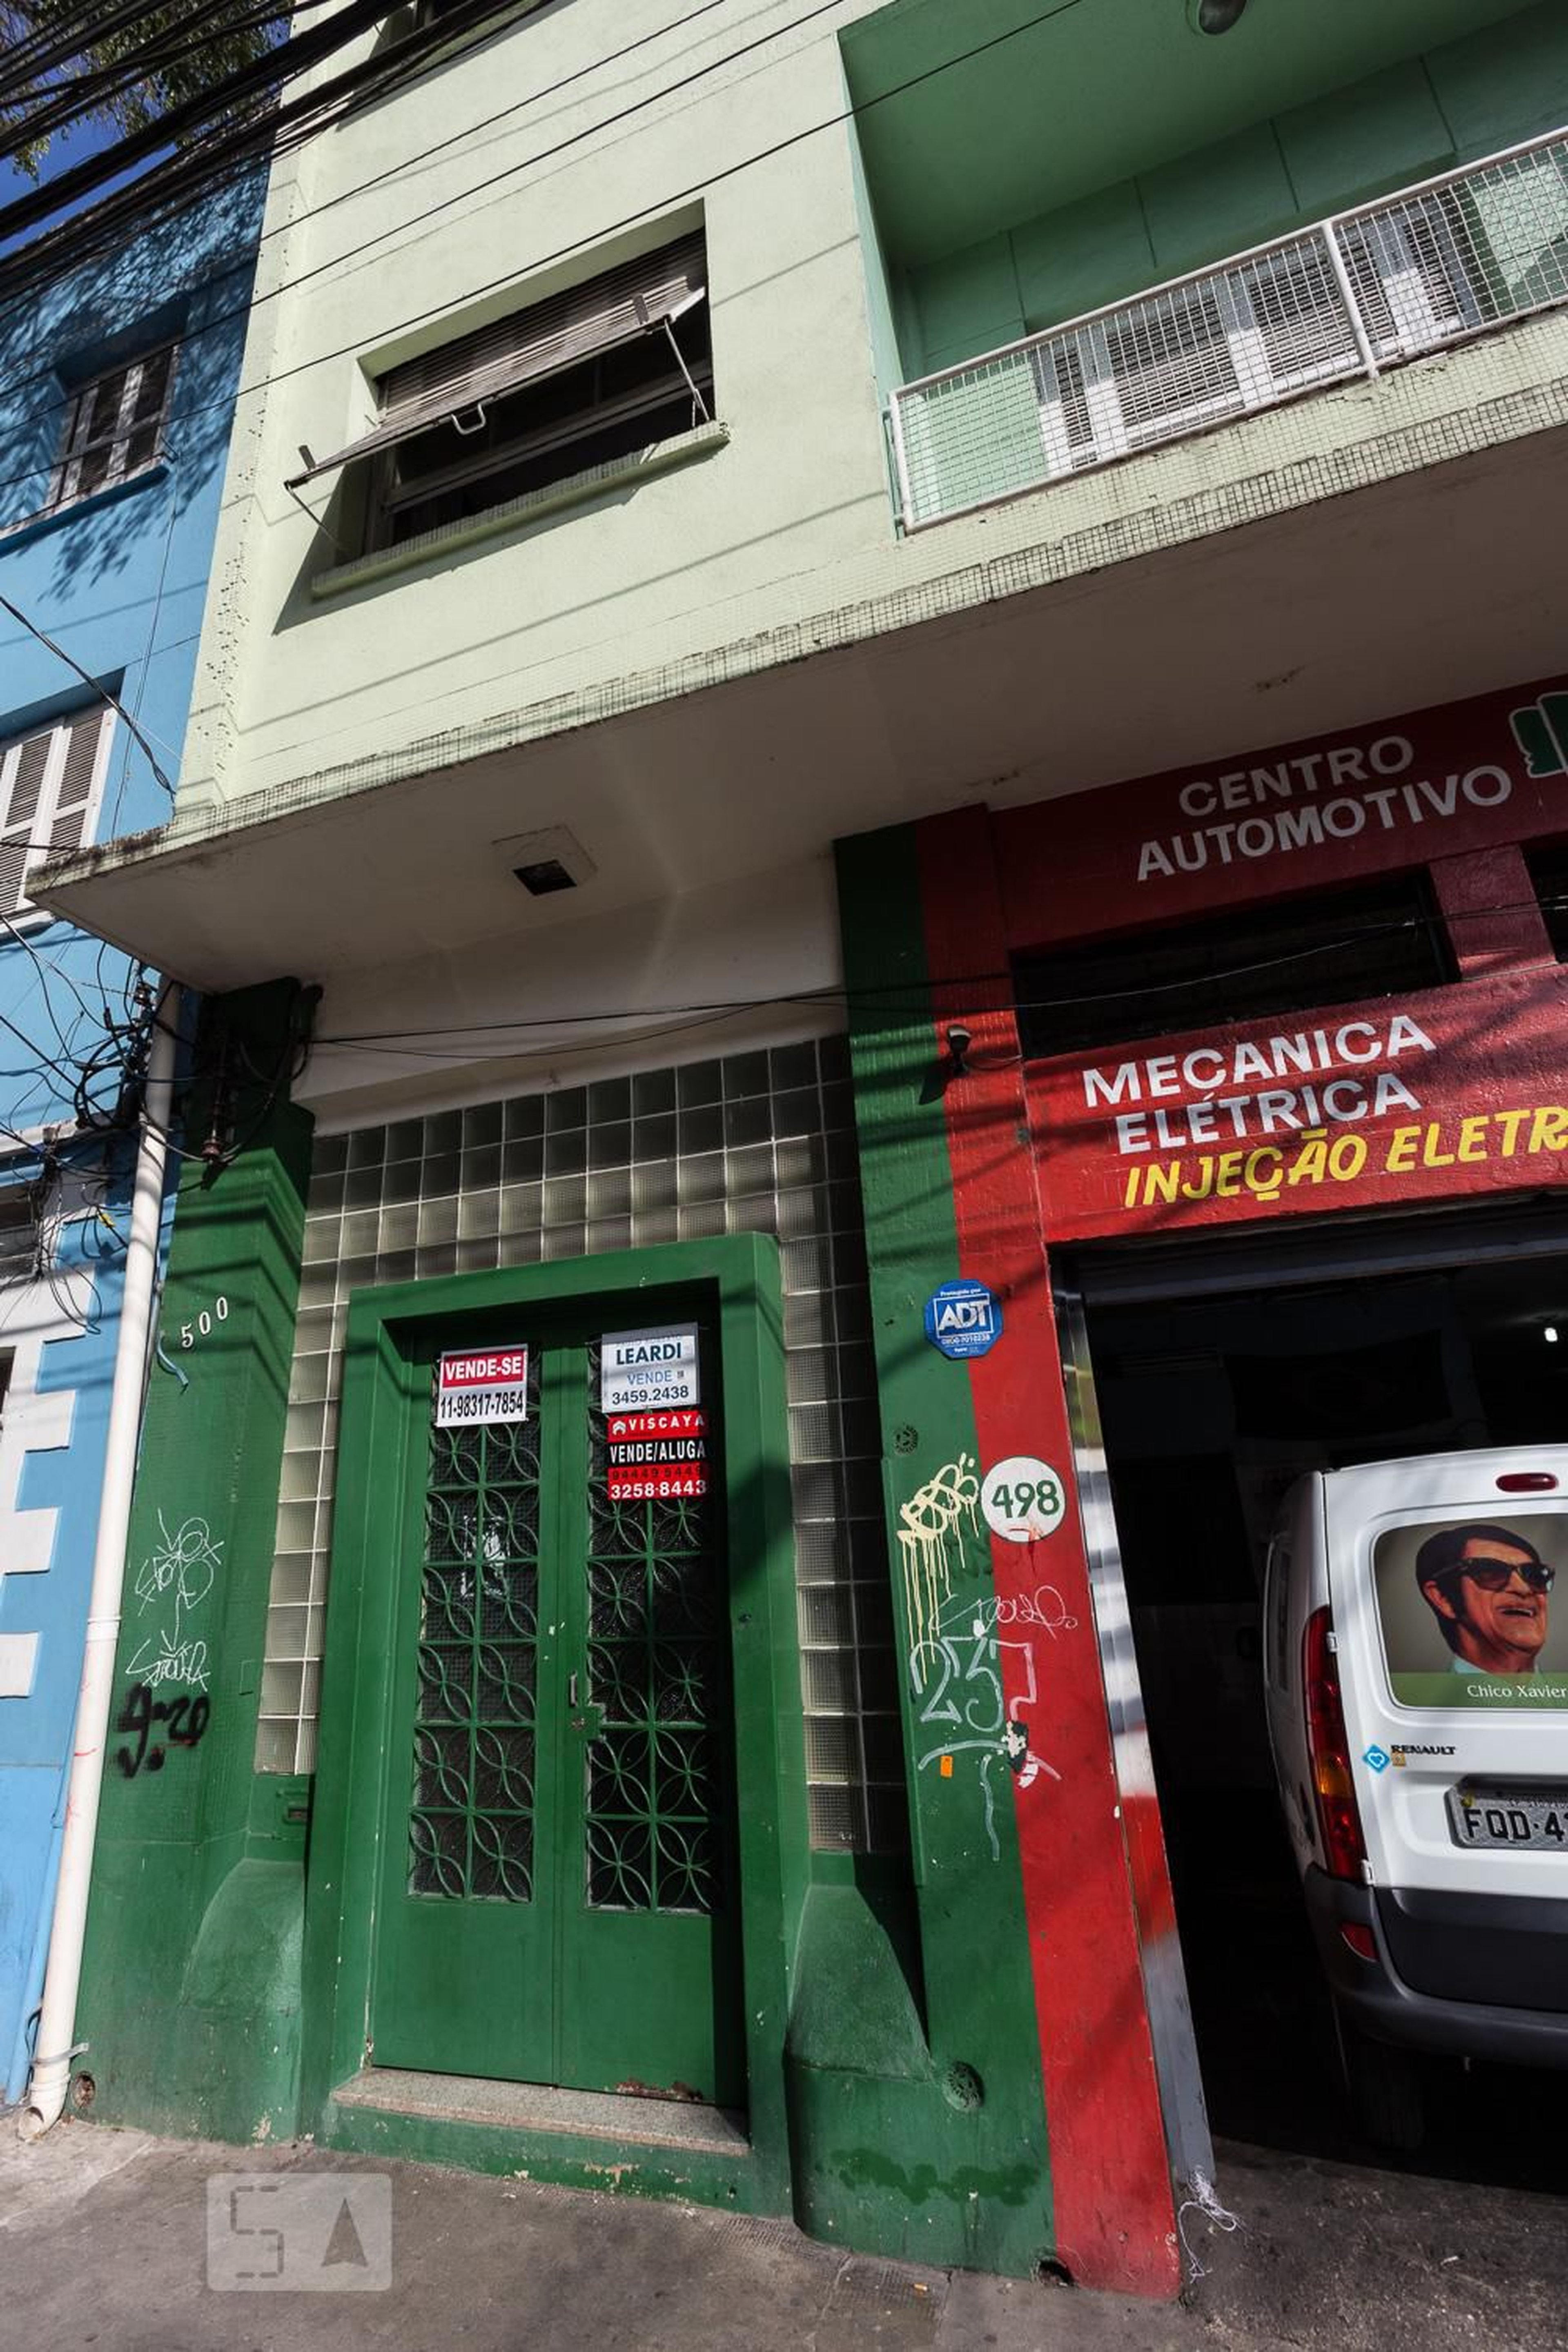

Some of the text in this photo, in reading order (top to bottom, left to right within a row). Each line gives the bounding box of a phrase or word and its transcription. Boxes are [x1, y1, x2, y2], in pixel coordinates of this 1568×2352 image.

[1179, 735, 1414, 816] CENTRO
[1137, 765, 1512, 882] AUTOMOTIVO
[1082, 1015, 1437, 1107] MECANICA
[1114, 1073, 1422, 1154] ELÉTRICA
[1124, 1129, 1368, 1208] INJEÇÃO
[181, 1296, 228, 1348] 500
[939, 1300, 990, 1331] ADT
[616, 1342, 681, 1365] LEARDI
[445, 1356, 522, 1381] VENDE-SE
[627, 1370, 673, 1385] VENDE
[612, 1385, 689, 1405] 3459.2438
[628, 1415, 704, 1430] VISCAYA
[610, 1440, 705, 1463] VENDE/ALUGA
[991, 1479, 1060, 1519] 498
[1467, 1684, 1567, 1698] Chico Xavier
[1391, 1745, 1456, 1755] RENAULT
